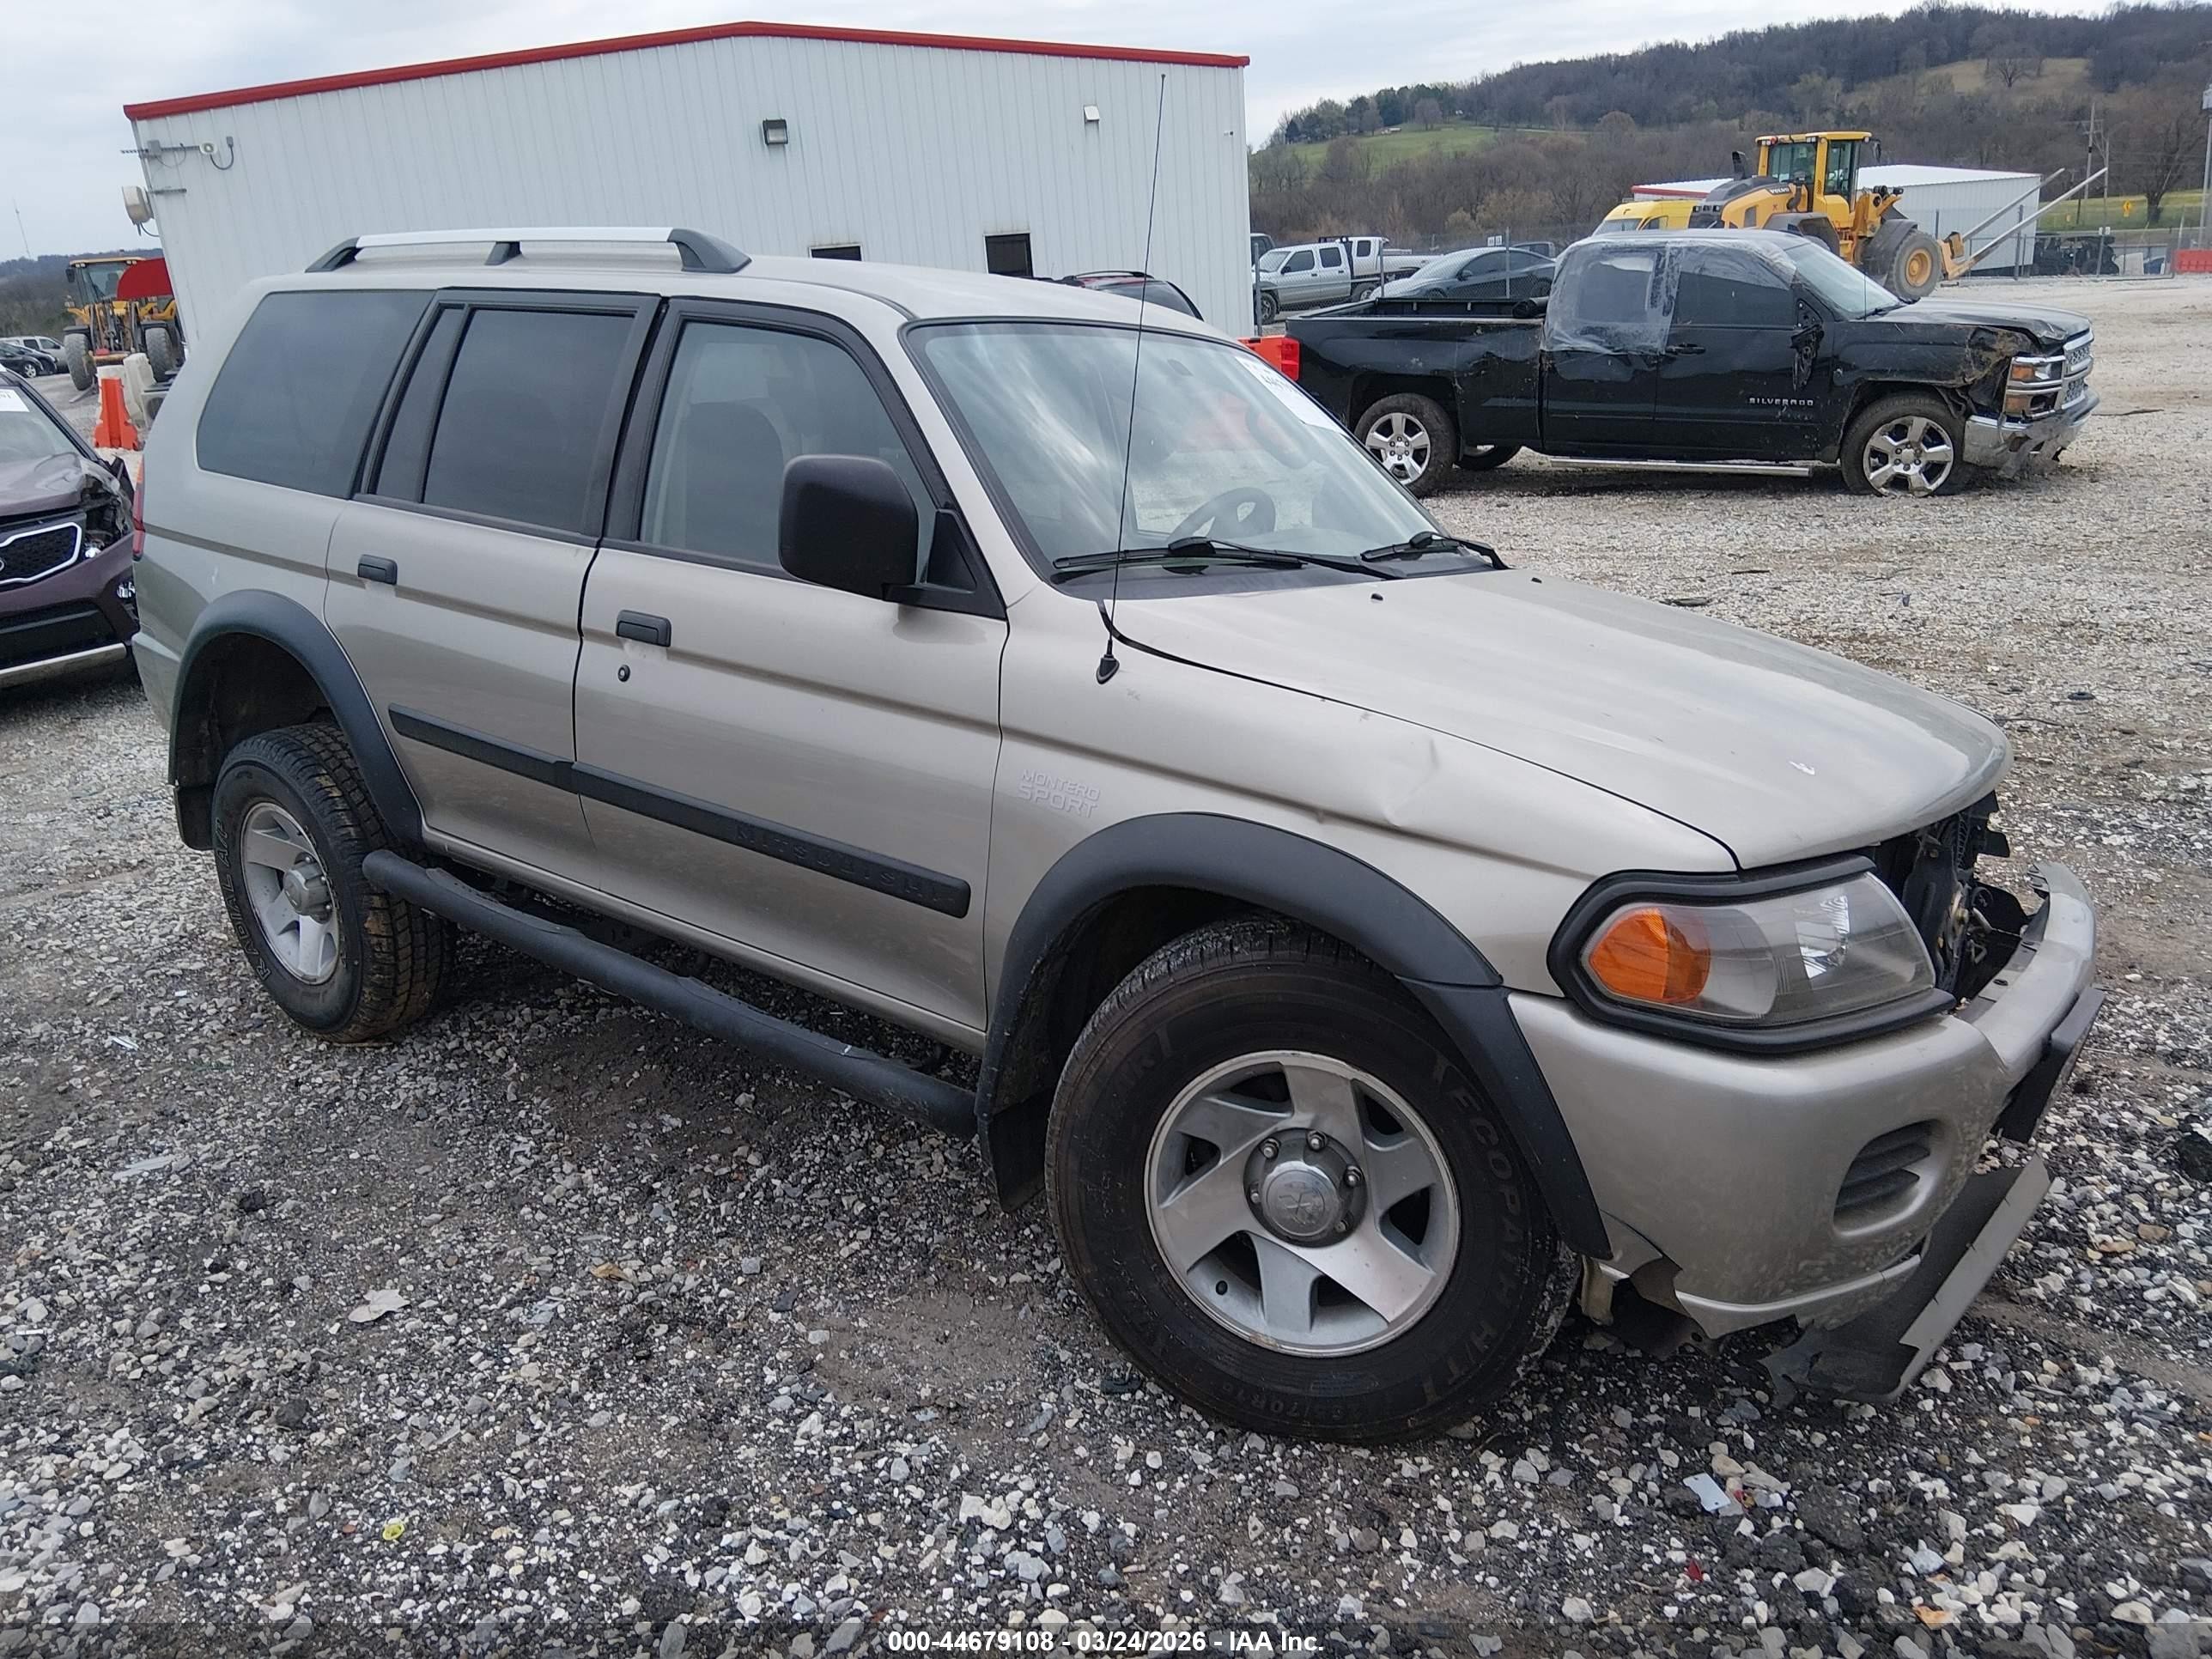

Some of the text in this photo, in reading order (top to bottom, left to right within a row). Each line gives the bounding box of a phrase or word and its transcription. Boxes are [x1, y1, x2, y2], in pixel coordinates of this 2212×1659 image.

[1749, 398, 1814, 406] SILVERADO
[1018, 783, 1098, 818] SPORT
[1023, 769, 1101, 801] MONTERO
[222, 873, 271, 981] RADIAL
